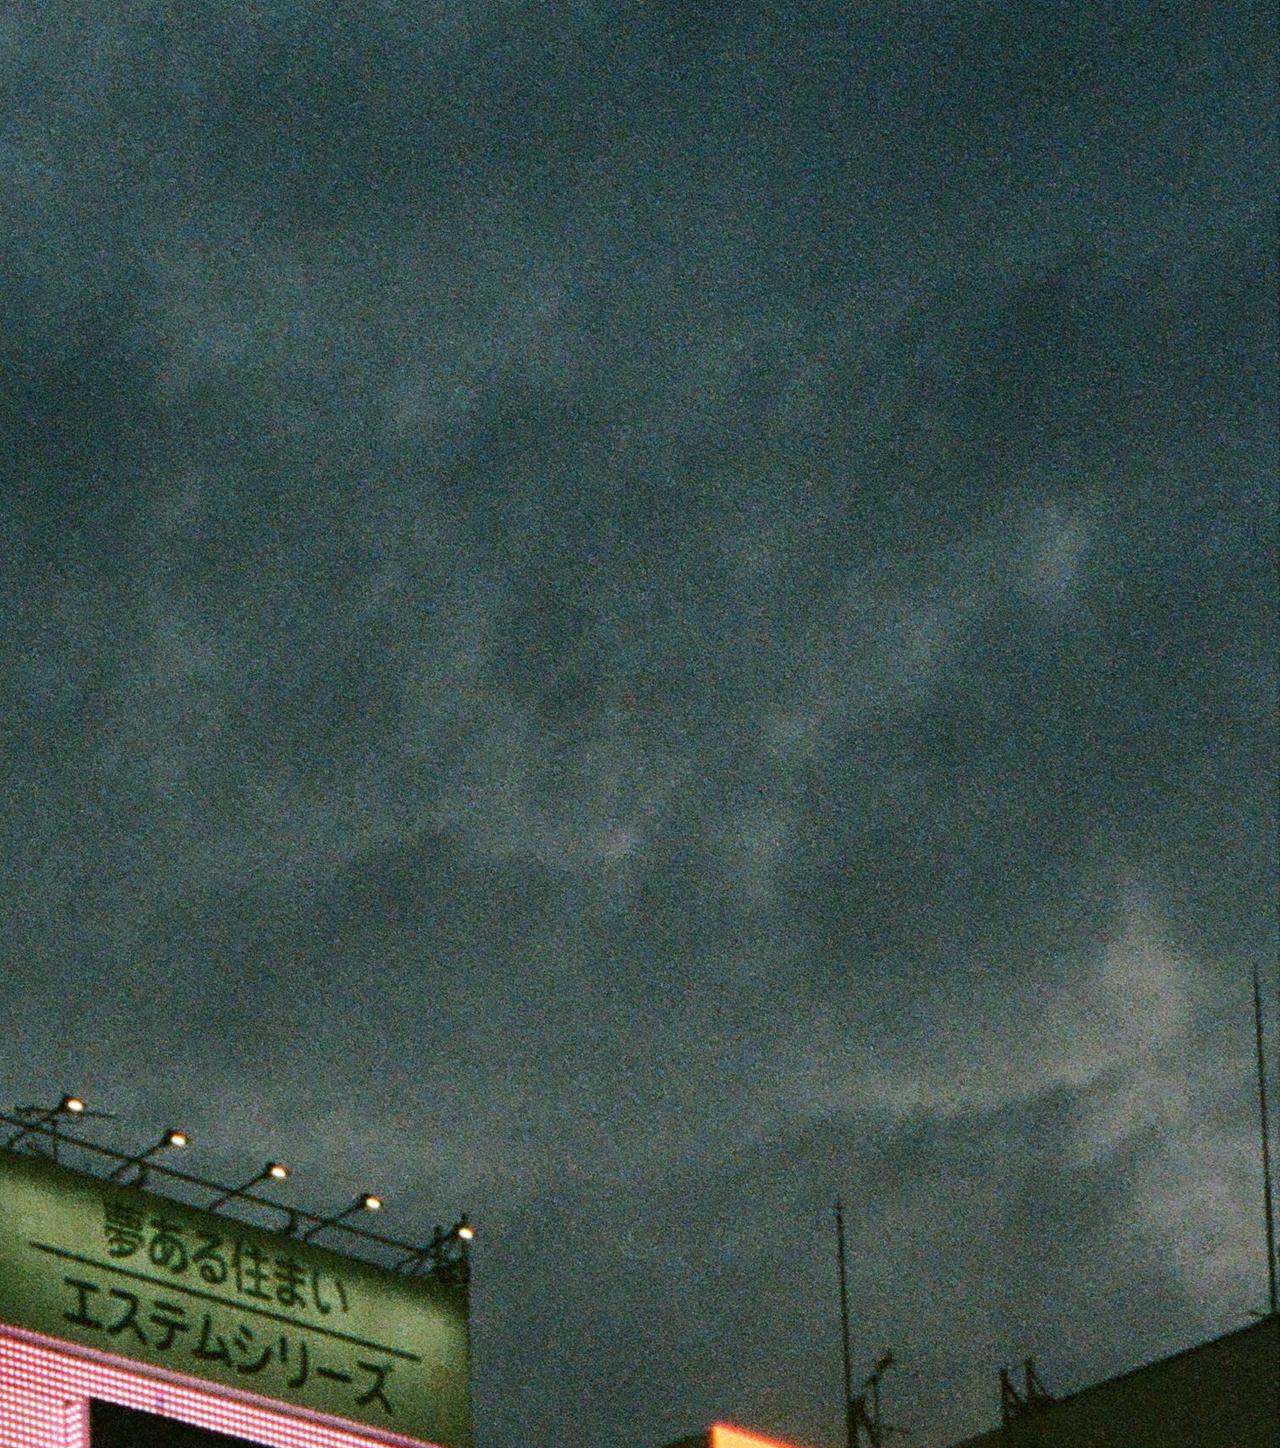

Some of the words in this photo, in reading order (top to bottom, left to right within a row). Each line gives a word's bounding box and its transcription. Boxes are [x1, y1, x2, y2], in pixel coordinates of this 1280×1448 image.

[104, 1199, 349, 1314] 夢ある住まい
